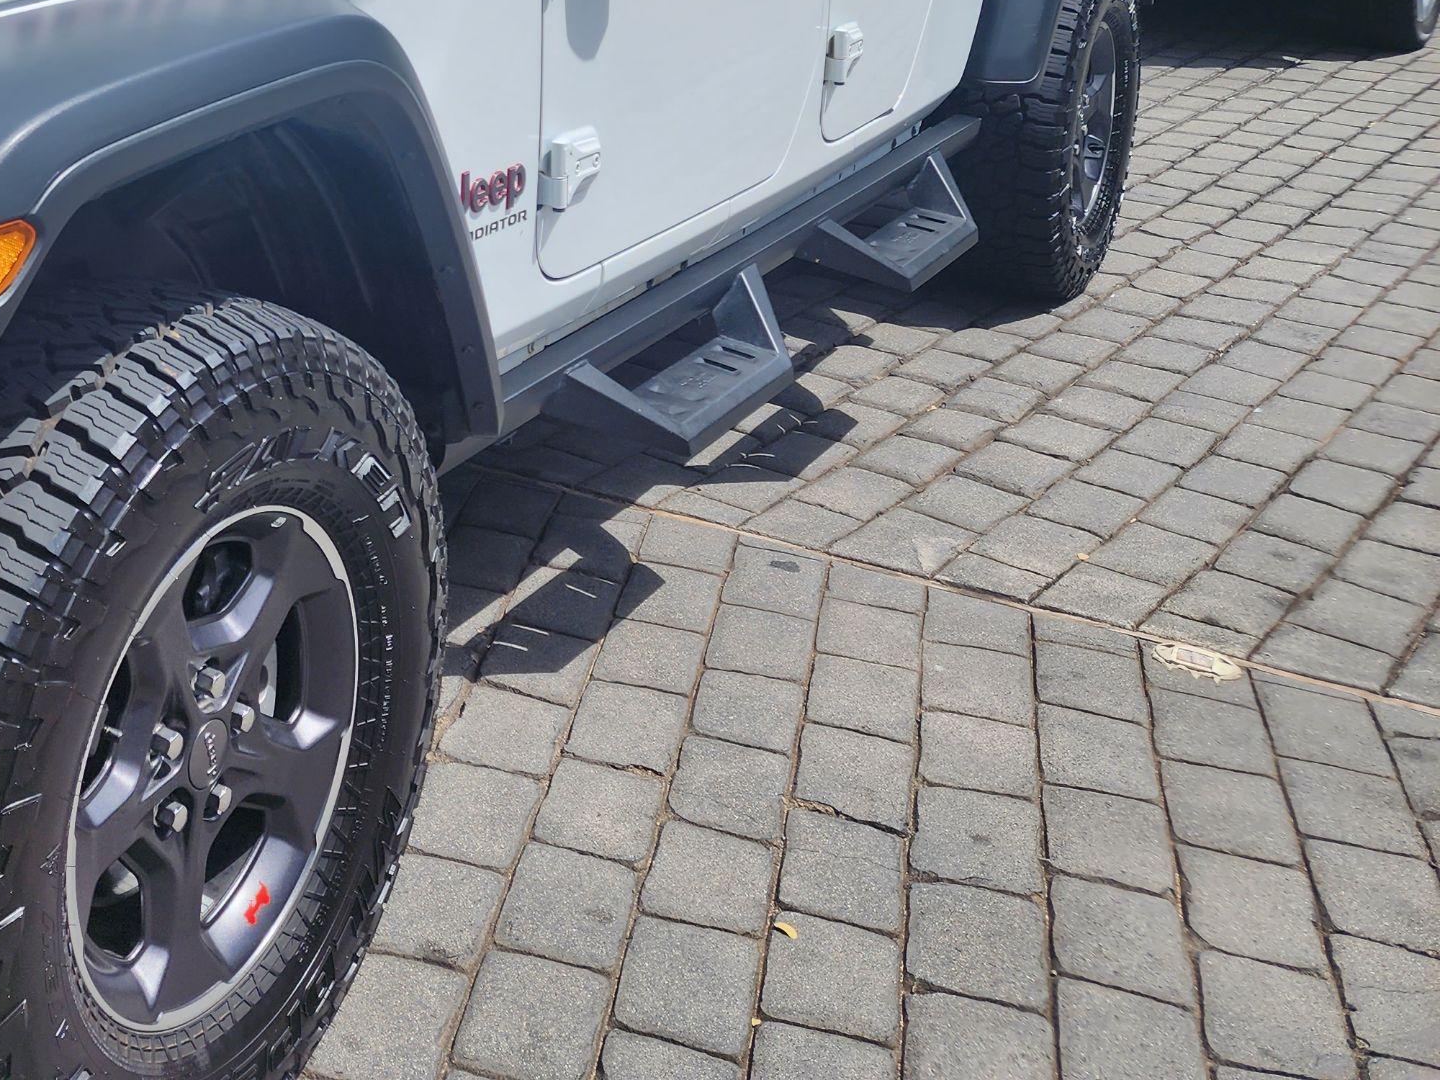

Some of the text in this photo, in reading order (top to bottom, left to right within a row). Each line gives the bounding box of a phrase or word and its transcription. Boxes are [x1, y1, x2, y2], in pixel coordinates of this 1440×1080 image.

[460, 163, 526, 213] Jeep
[469, 209, 528, 241] DIATOR
[194, 424, 412, 539] FALKEN
